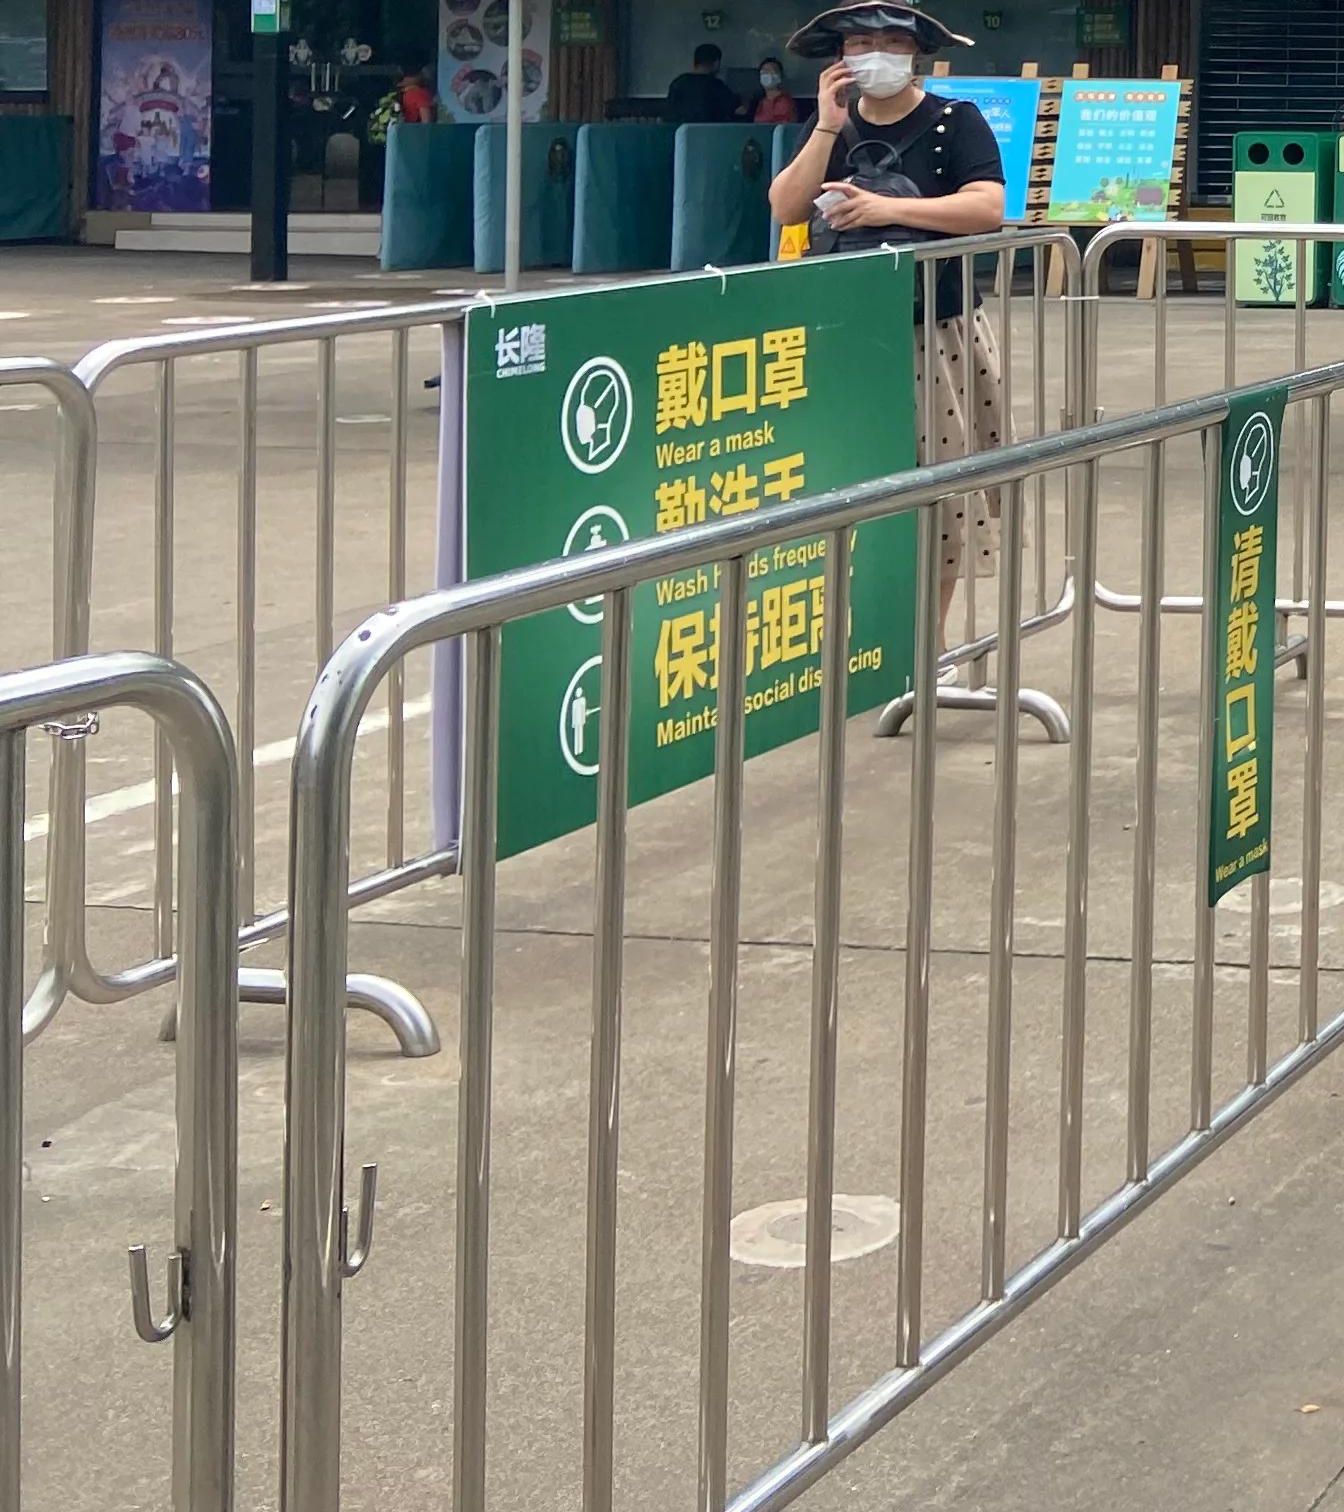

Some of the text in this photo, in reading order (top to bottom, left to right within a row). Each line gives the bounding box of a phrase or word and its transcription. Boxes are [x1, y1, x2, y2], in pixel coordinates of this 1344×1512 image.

[985, 15, 1000, 28] 10
[494, 323, 546, 367] 长隆
[655, 326, 808, 435] 戴口罩
[656, 420, 775, 469] Wear a mask
[656, 569, 708, 606] Wash
[657, 646, 882, 748] Mainta social discing
[1224, 524, 1263, 840] 请戴口罩
[1215, 841, 1269, 884] Wear a mask
